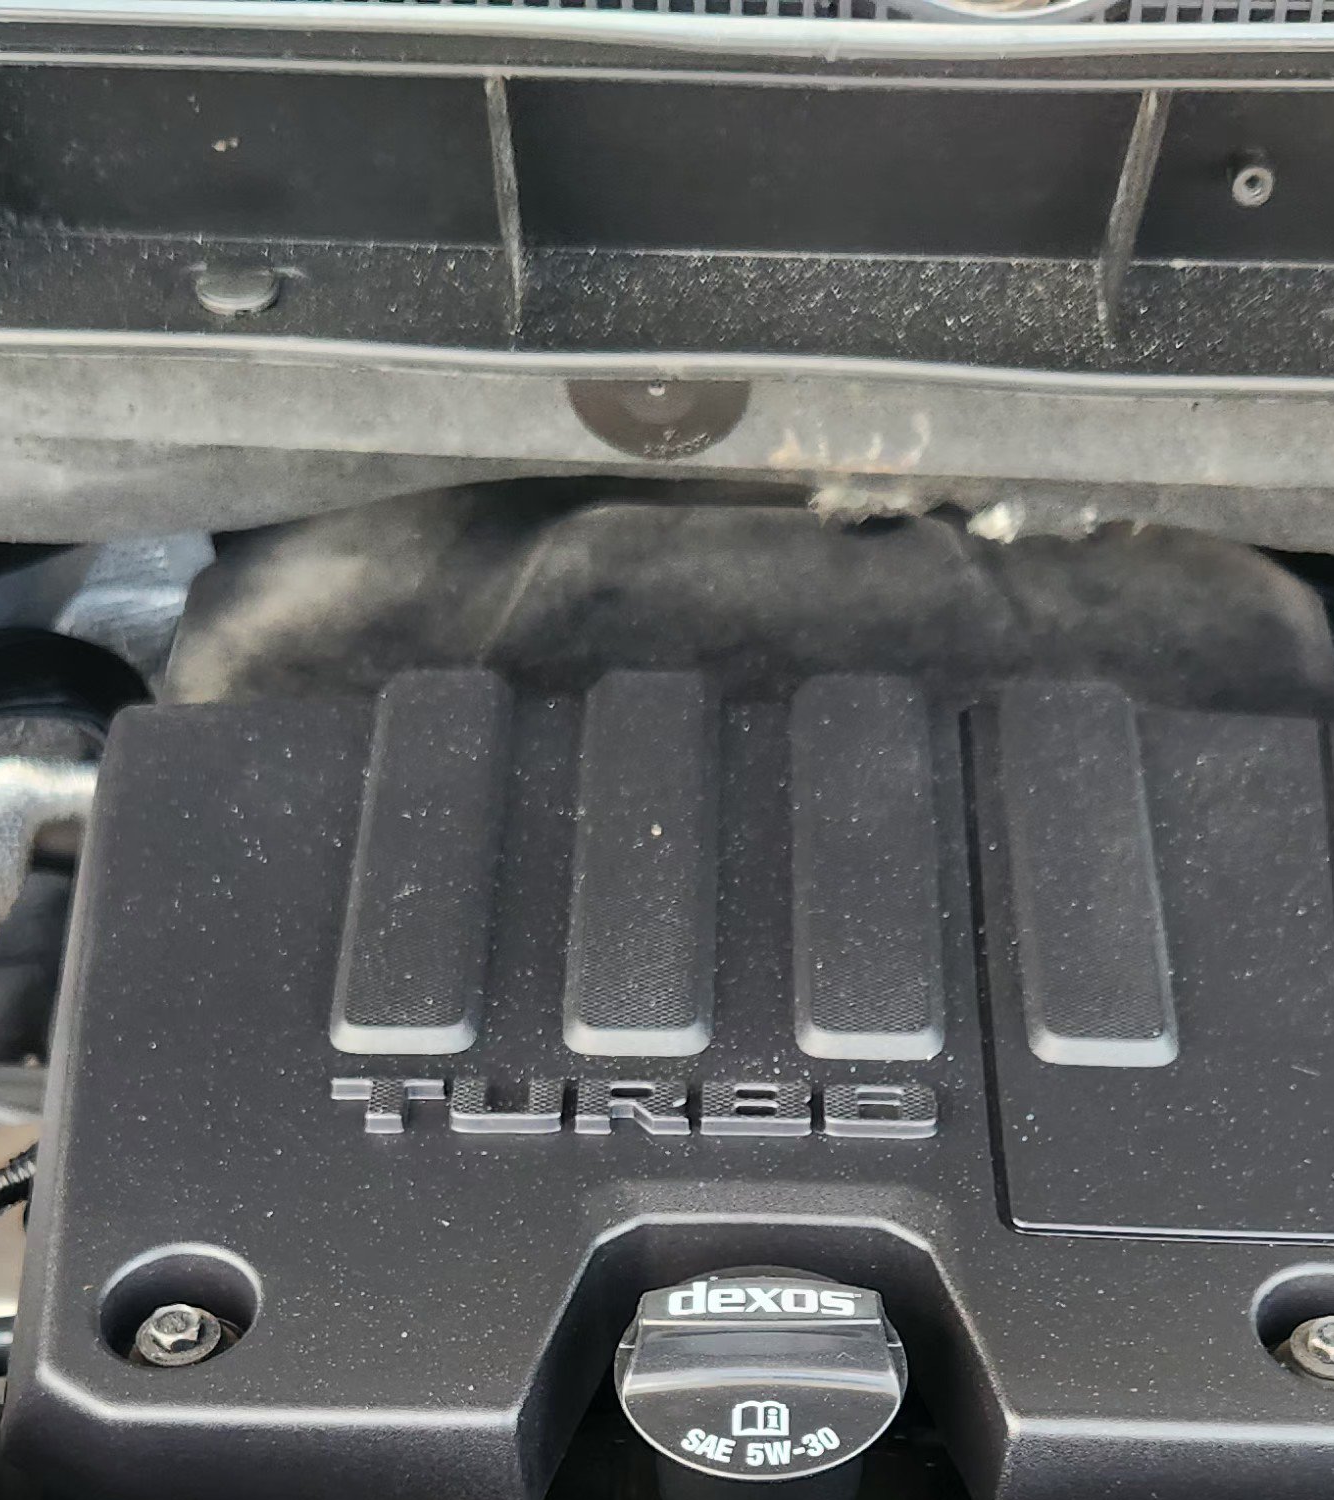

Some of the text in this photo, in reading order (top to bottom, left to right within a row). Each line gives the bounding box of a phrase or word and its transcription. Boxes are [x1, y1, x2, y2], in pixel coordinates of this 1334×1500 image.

[330, 1077, 939, 1138] TURBO
[667, 1281, 855, 1316] dexos
[680, 1426, 841, 1467] SAE 5W-30
